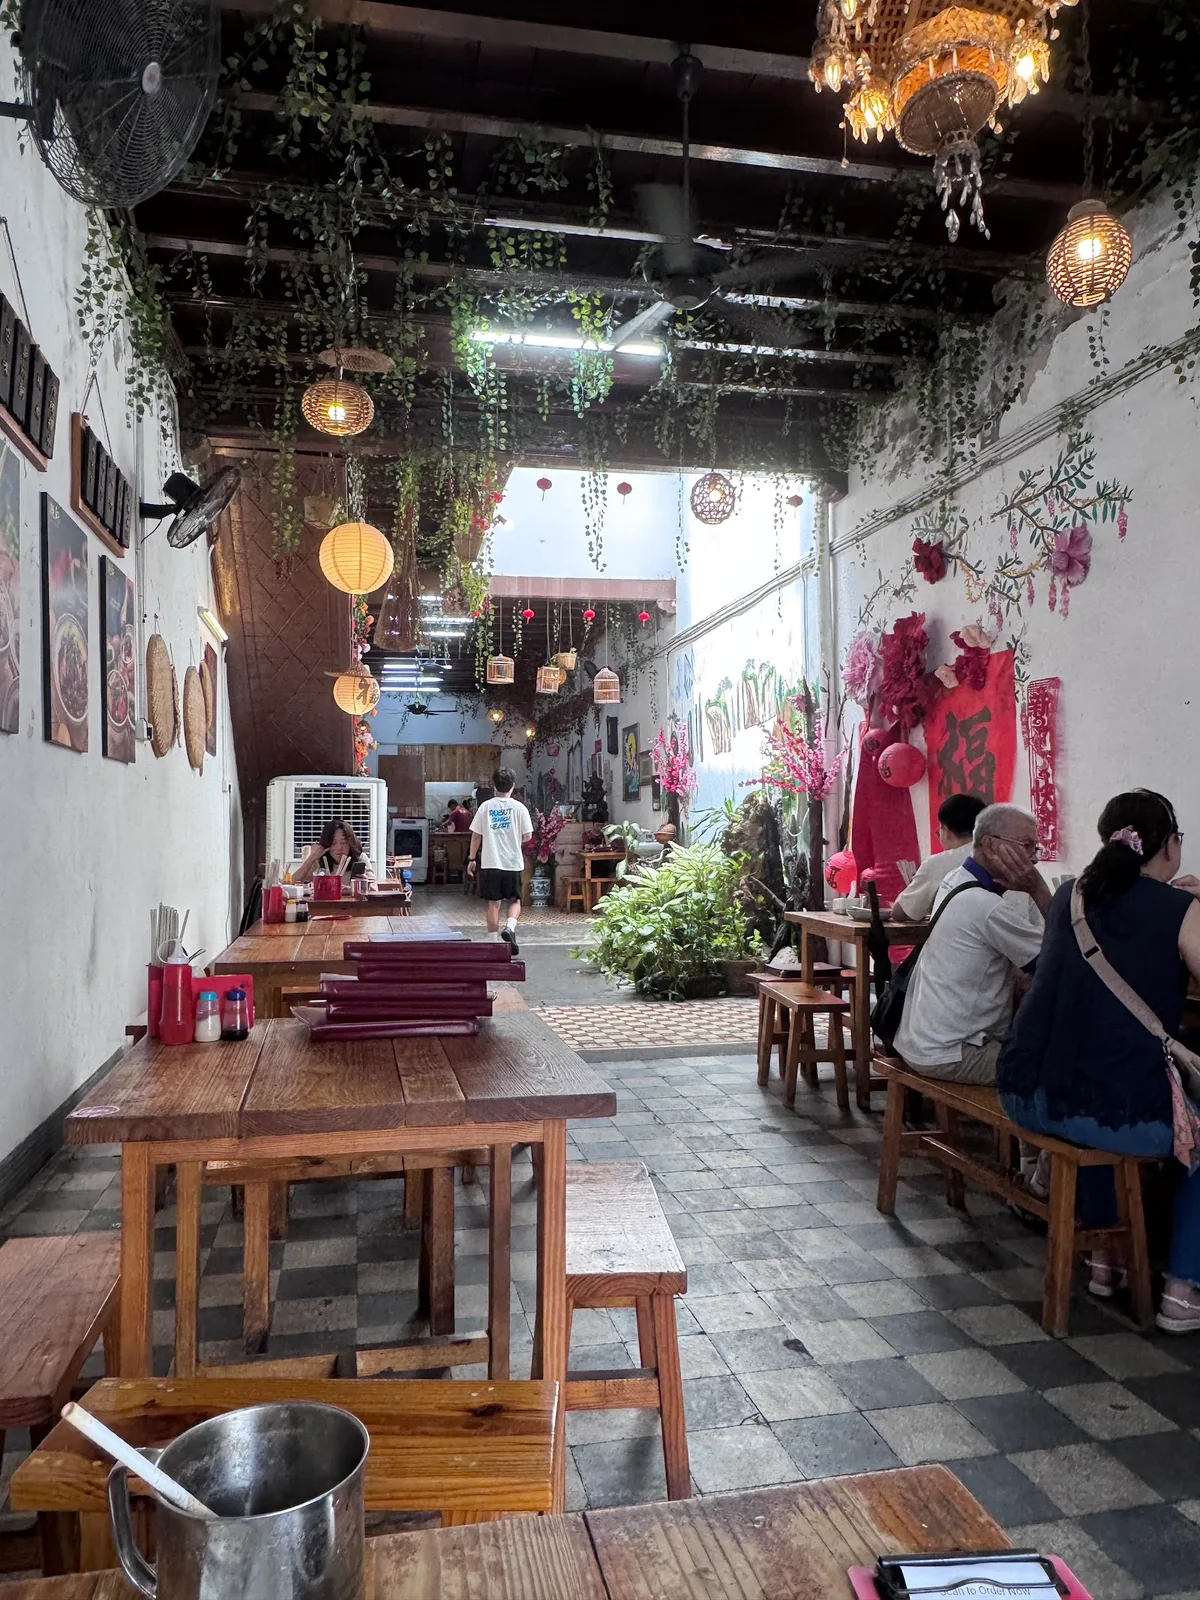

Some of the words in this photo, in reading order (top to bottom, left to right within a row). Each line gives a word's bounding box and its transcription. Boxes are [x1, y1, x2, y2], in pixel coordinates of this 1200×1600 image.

[937, 706, 996, 806] 福
[966, 1586, 976, 1596] to
[978, 1585, 1005, 1596] Order
[1007, 1587, 1031, 1596] Now
